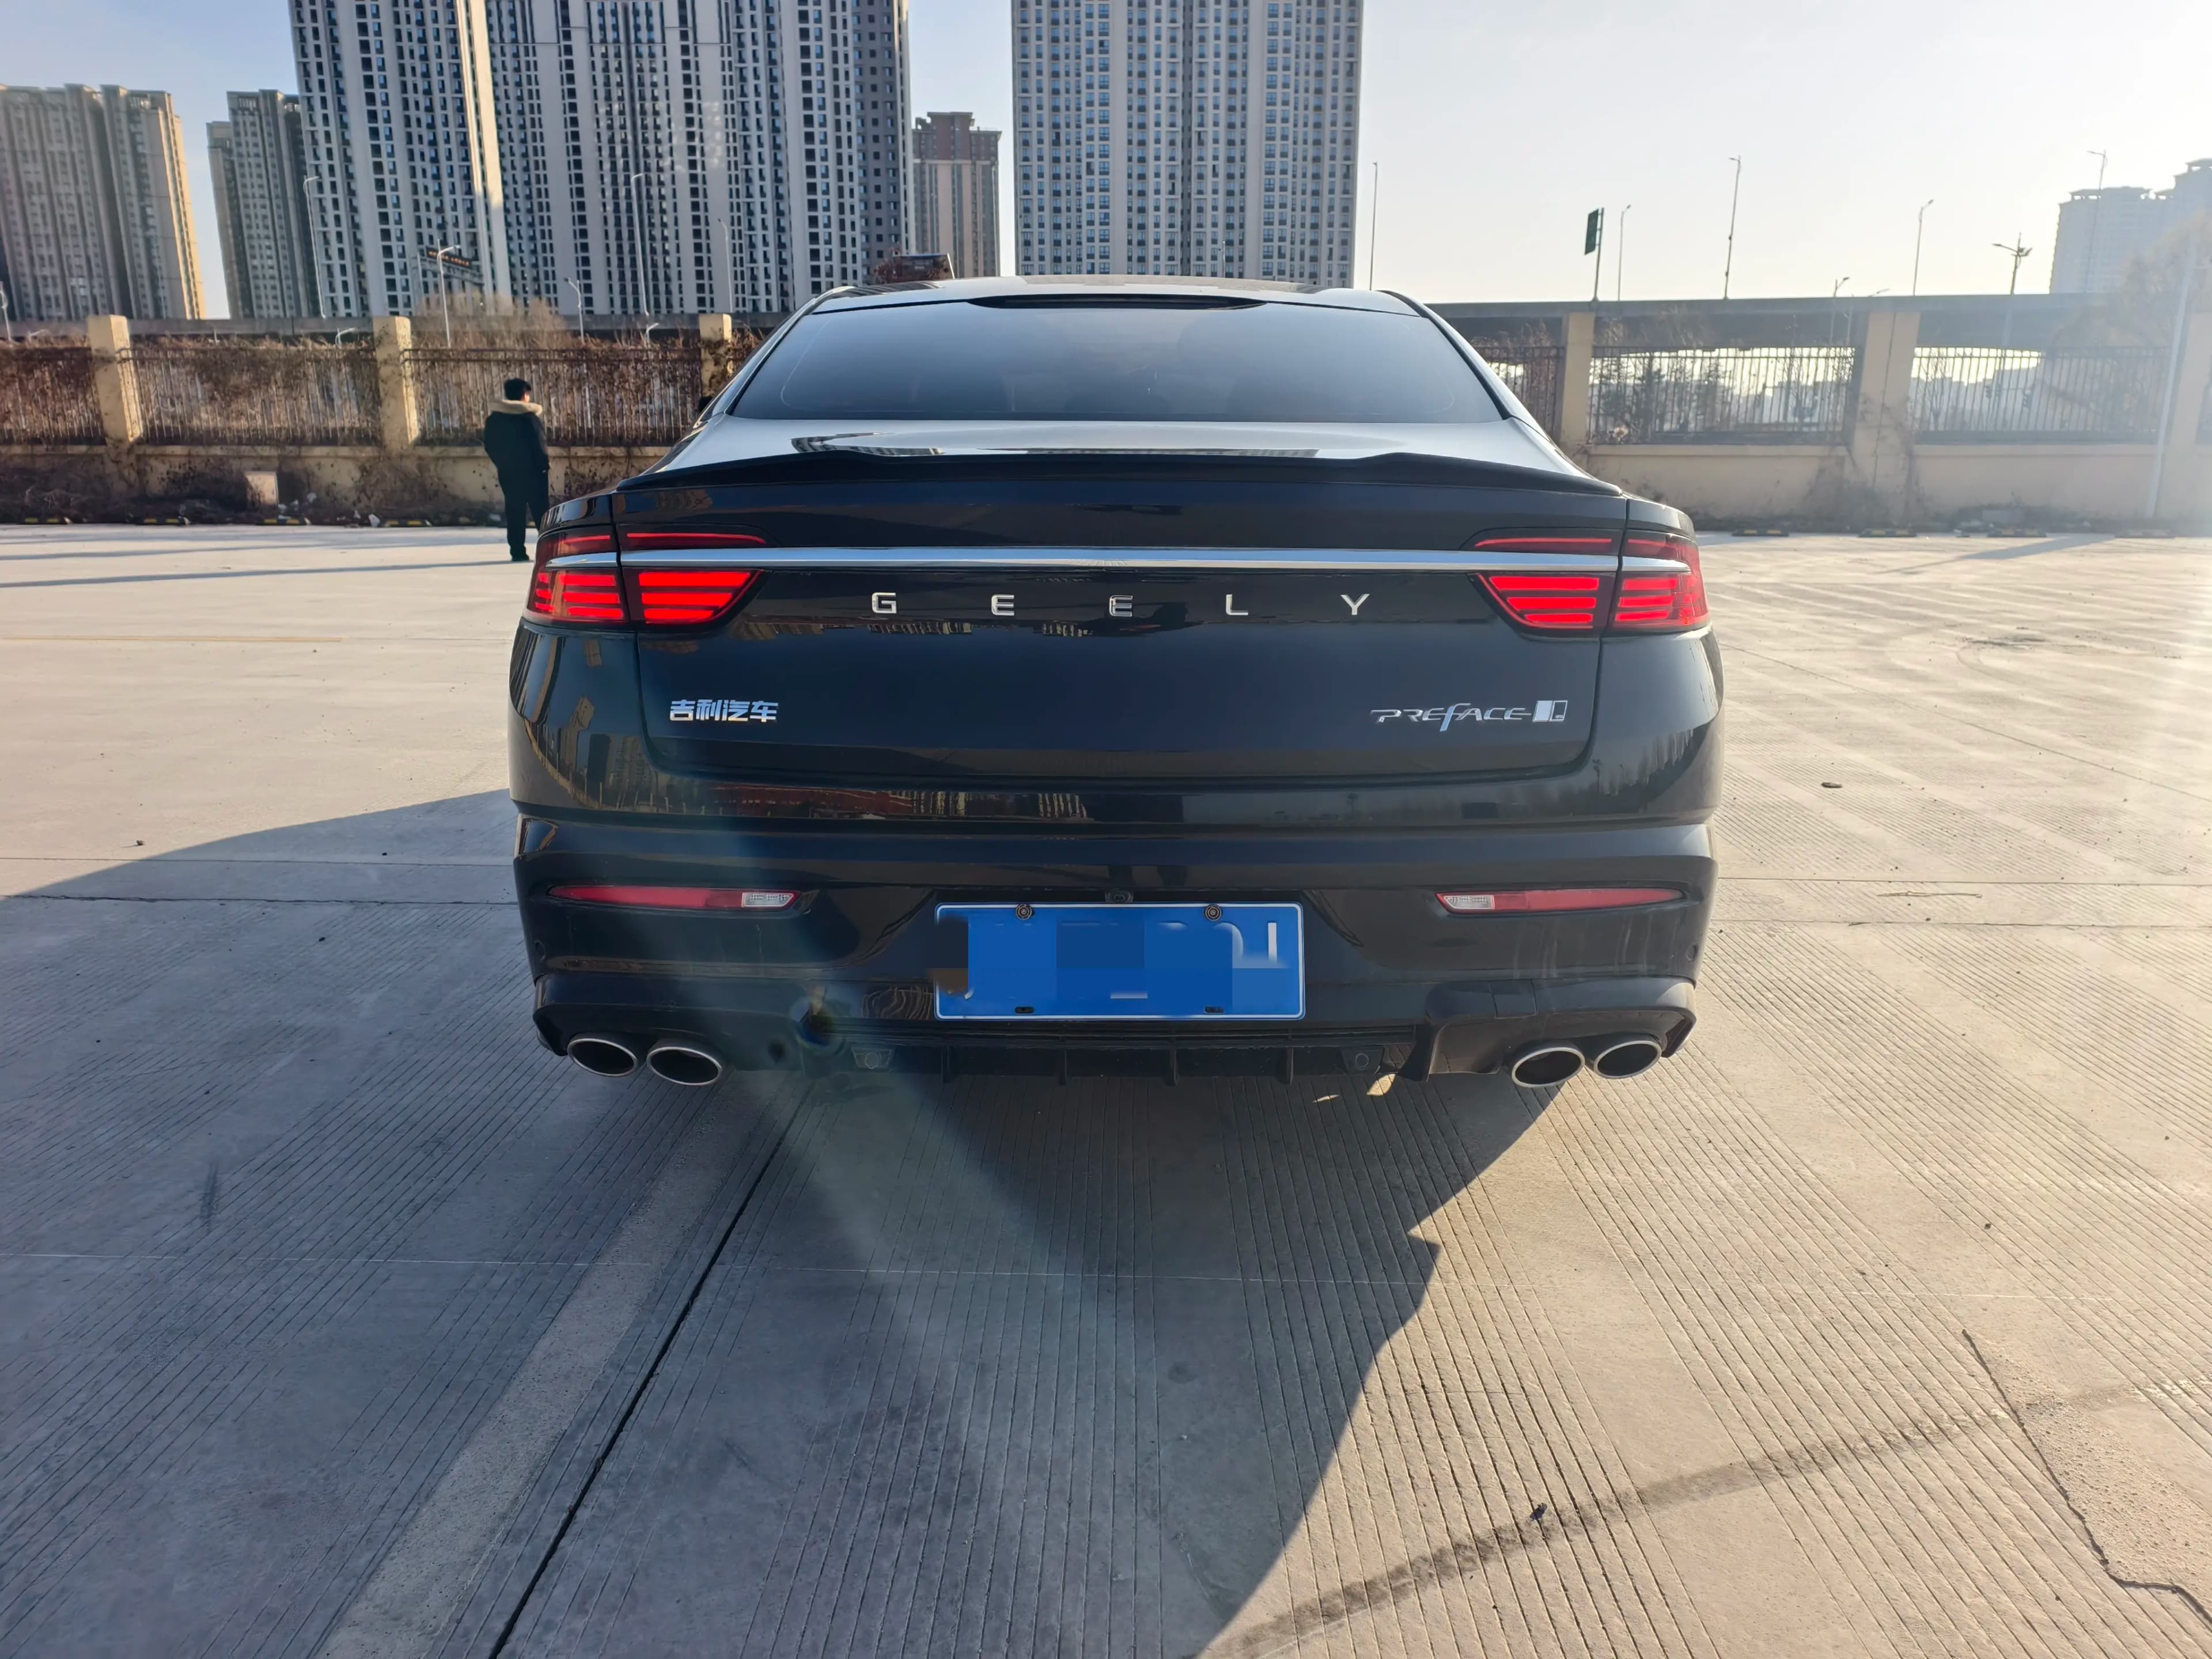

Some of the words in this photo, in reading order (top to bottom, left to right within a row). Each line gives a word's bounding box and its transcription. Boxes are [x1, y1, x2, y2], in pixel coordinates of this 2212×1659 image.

[872, 592, 1370, 615] GEELY
[669, 699, 779, 722] 吉利汽车
